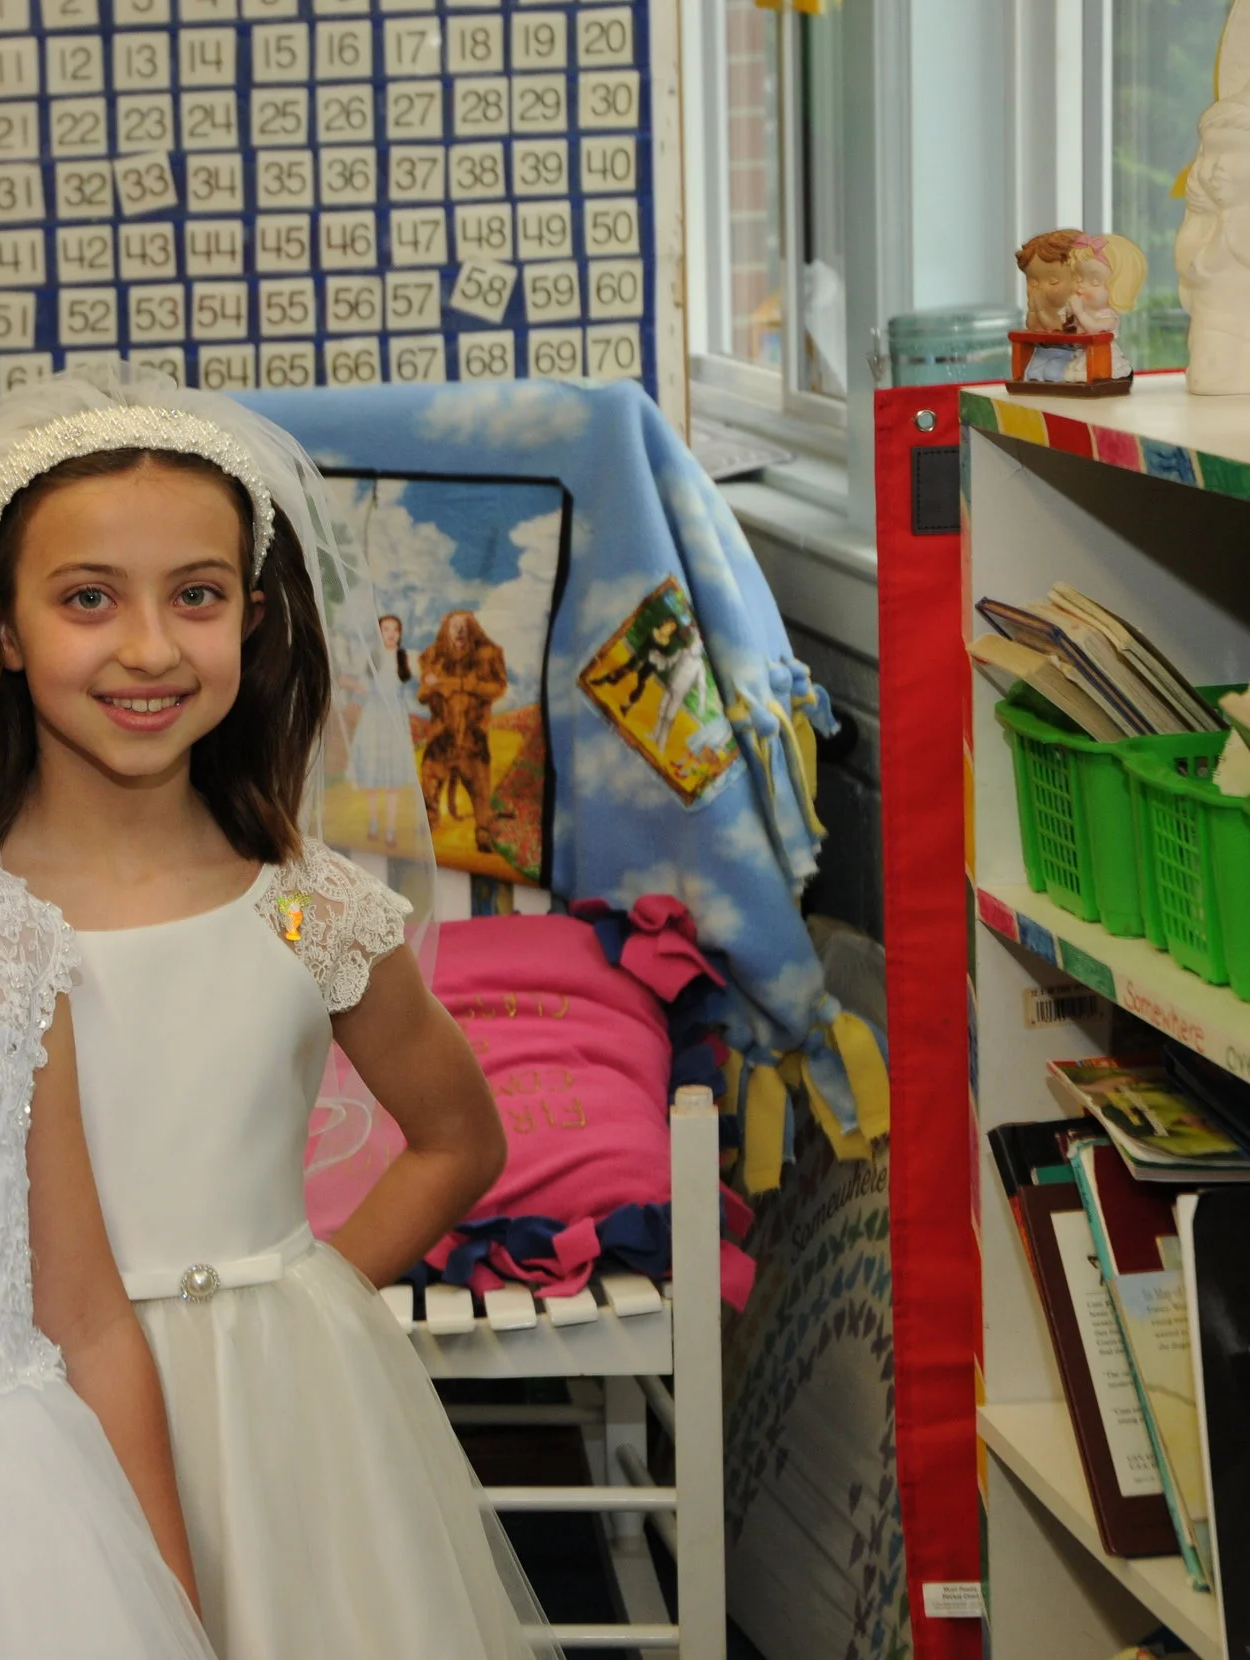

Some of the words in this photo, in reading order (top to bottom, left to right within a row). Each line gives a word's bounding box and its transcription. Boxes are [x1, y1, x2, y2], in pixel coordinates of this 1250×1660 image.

[60, 46, 92, 81] 12
[125, 44, 157, 79] 13
[189, 40, 223, 73] 14
[264, 35, 296, 69] 15
[327, 32, 360, 66] 16
[396, 31, 426, 63] 17
[459, 27, 491, 61] 18
[524, 24, 555, 57] 19
[584, 20, 626, 54] 20
[57, 111, 100, 145] 22
[124, 106, 167, 142] 23
[189, 103, 233, 138] 24
[259, 100, 301, 135] 25
[323, 96, 366, 131] 26
[393, 93, 435, 127] 27
[461, 89, 502, 122] 28
[520, 88, 561, 121] 29
[591, 83, 632, 116] 30
[63, 172, 109, 206] 32
[122, 163, 169, 200] 33
[191, 166, 237, 200] 34
[264, 161, 307, 195] 35
[327, 158, 370, 191] 36
[396, 158, 438, 191] 37
[457, 154, 499, 189] 38
[521, 151, 563, 185] 39
[587, 148, 630, 182] 40
[62, 236, 109, 270] 42
[125, 232, 171, 266] 43
[190, 229, 236, 263] 44
[260, 226, 305, 260] 45
[326, 223, 372, 256] 46
[397, 220, 441, 252] 47
[462, 216, 506, 249] 48
[522, 213, 567, 247] 49
[592, 210, 632, 245] 50
[68, 300, 110, 333] 52
[135, 297, 179, 330] 53
[198, 294, 242, 327] 54
[266, 290, 309, 325] 55
[332, 287, 375, 321] 56
[392, 284, 433, 317] 57
[460, 266, 506, 308] 58
[531, 273, 574, 308] 59
[596, 271, 637, 305] 60
[204, 356, 248, 389] 64
[266, 354, 309, 387] 65
[332, 349, 375, 383] 66
[397, 347, 438, 380] 67
[465, 343, 508, 377] 68
[534, 340, 577, 374] 69
[592, 336, 634, 371] 70
